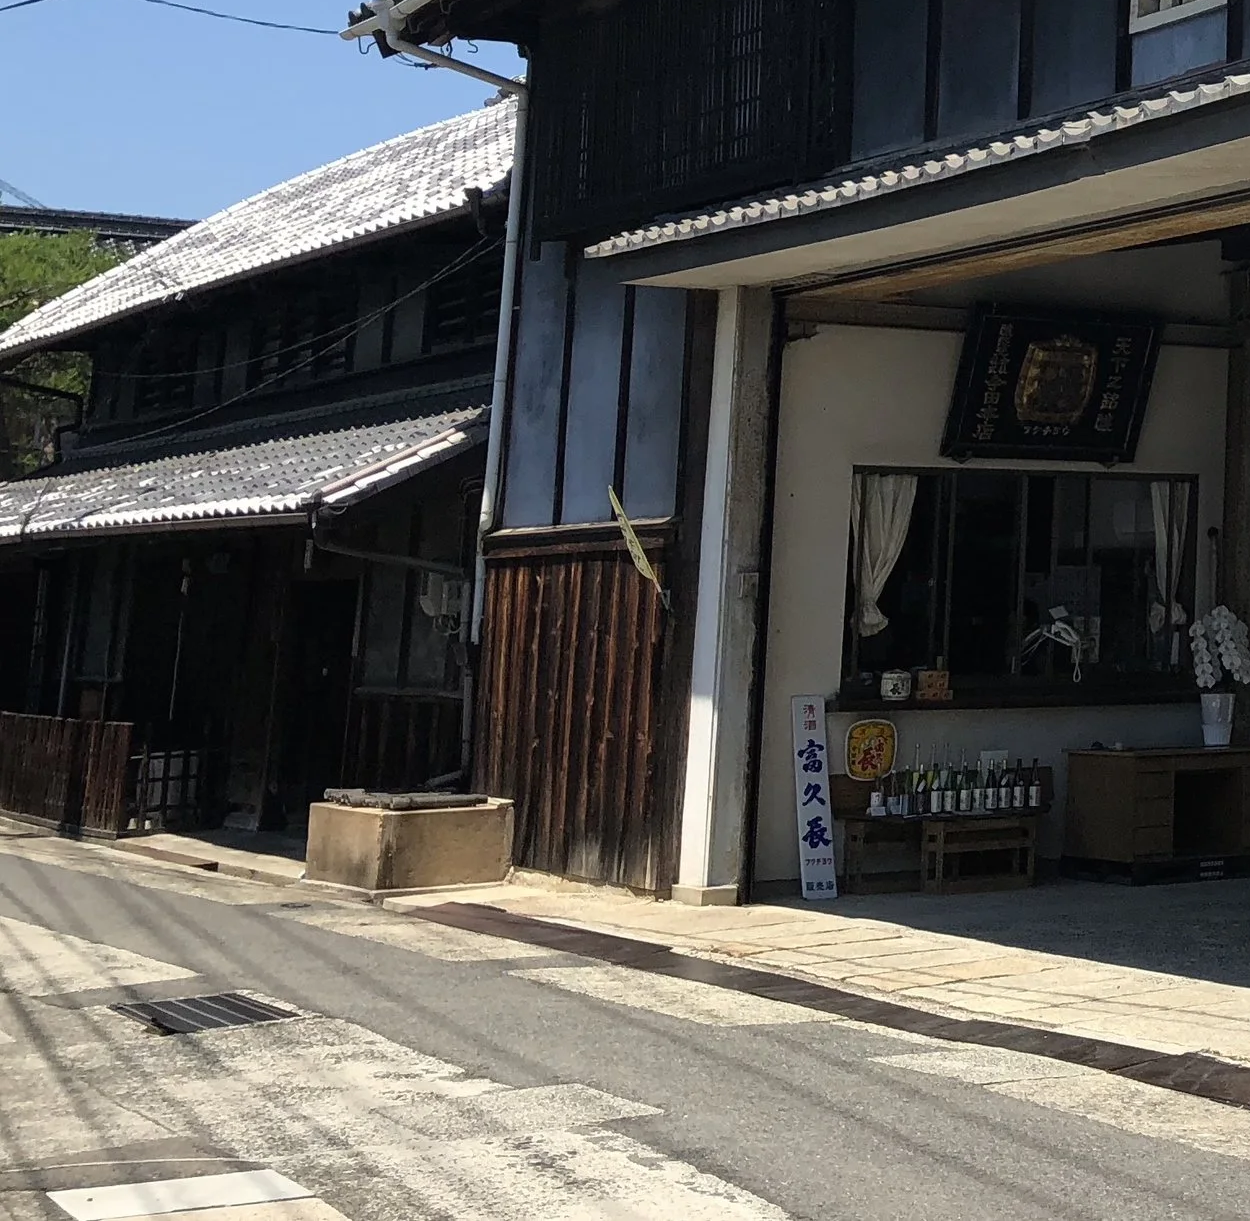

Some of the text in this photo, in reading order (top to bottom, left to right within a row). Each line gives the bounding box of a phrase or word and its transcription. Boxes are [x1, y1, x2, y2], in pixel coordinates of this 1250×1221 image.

[803, 704, 817, 731] 清酒
[797, 738, 832, 849] 富久長
